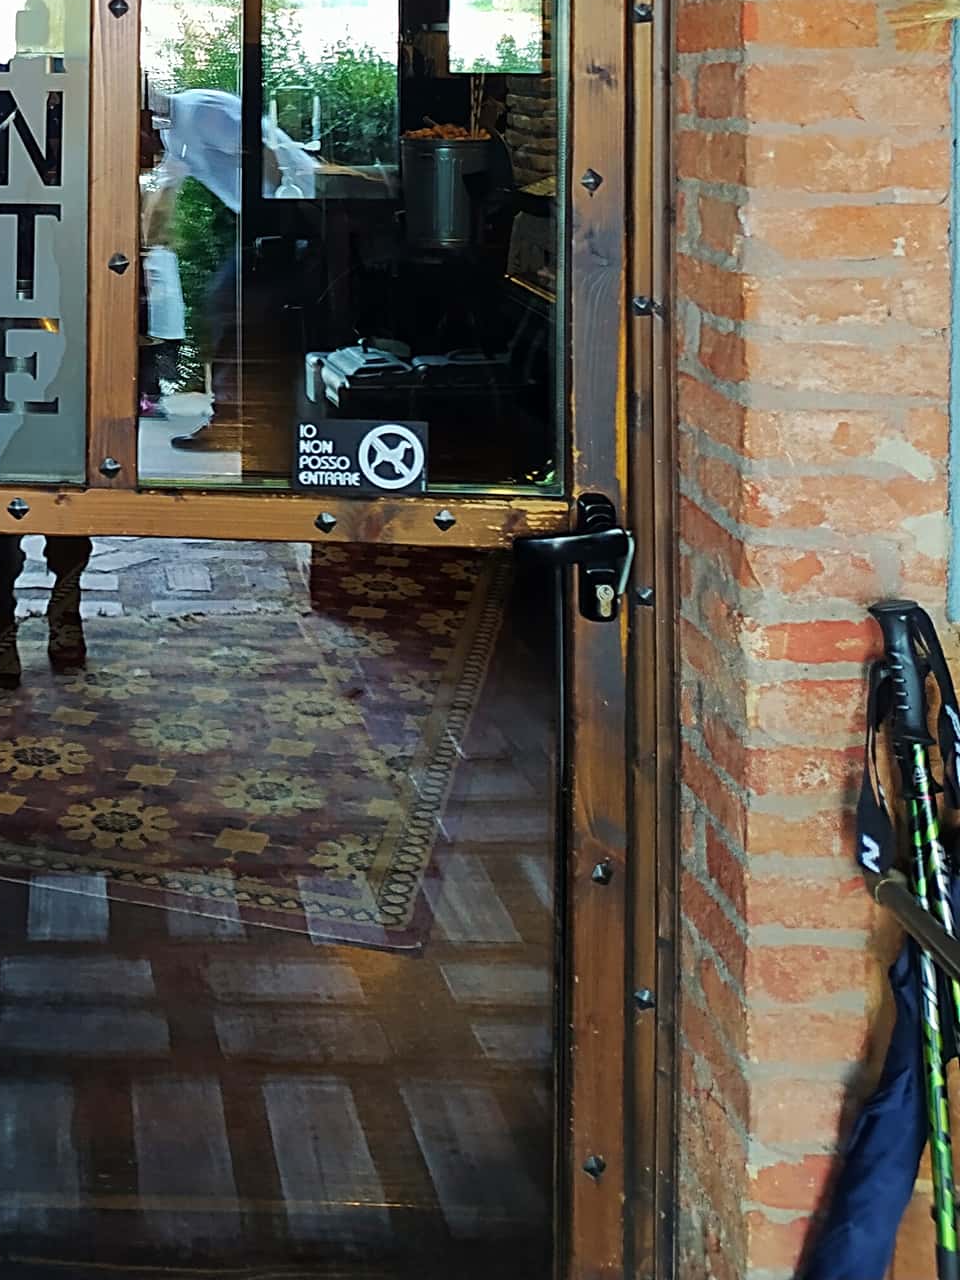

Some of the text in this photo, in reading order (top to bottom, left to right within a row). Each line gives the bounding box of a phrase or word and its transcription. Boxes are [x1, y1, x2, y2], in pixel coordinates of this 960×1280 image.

[300, 424, 317, 438] IO
[300, 440, 333, 454] NON
[300, 455, 350, 470] POSSO
[299, 471, 360, 486] ENTRARE
